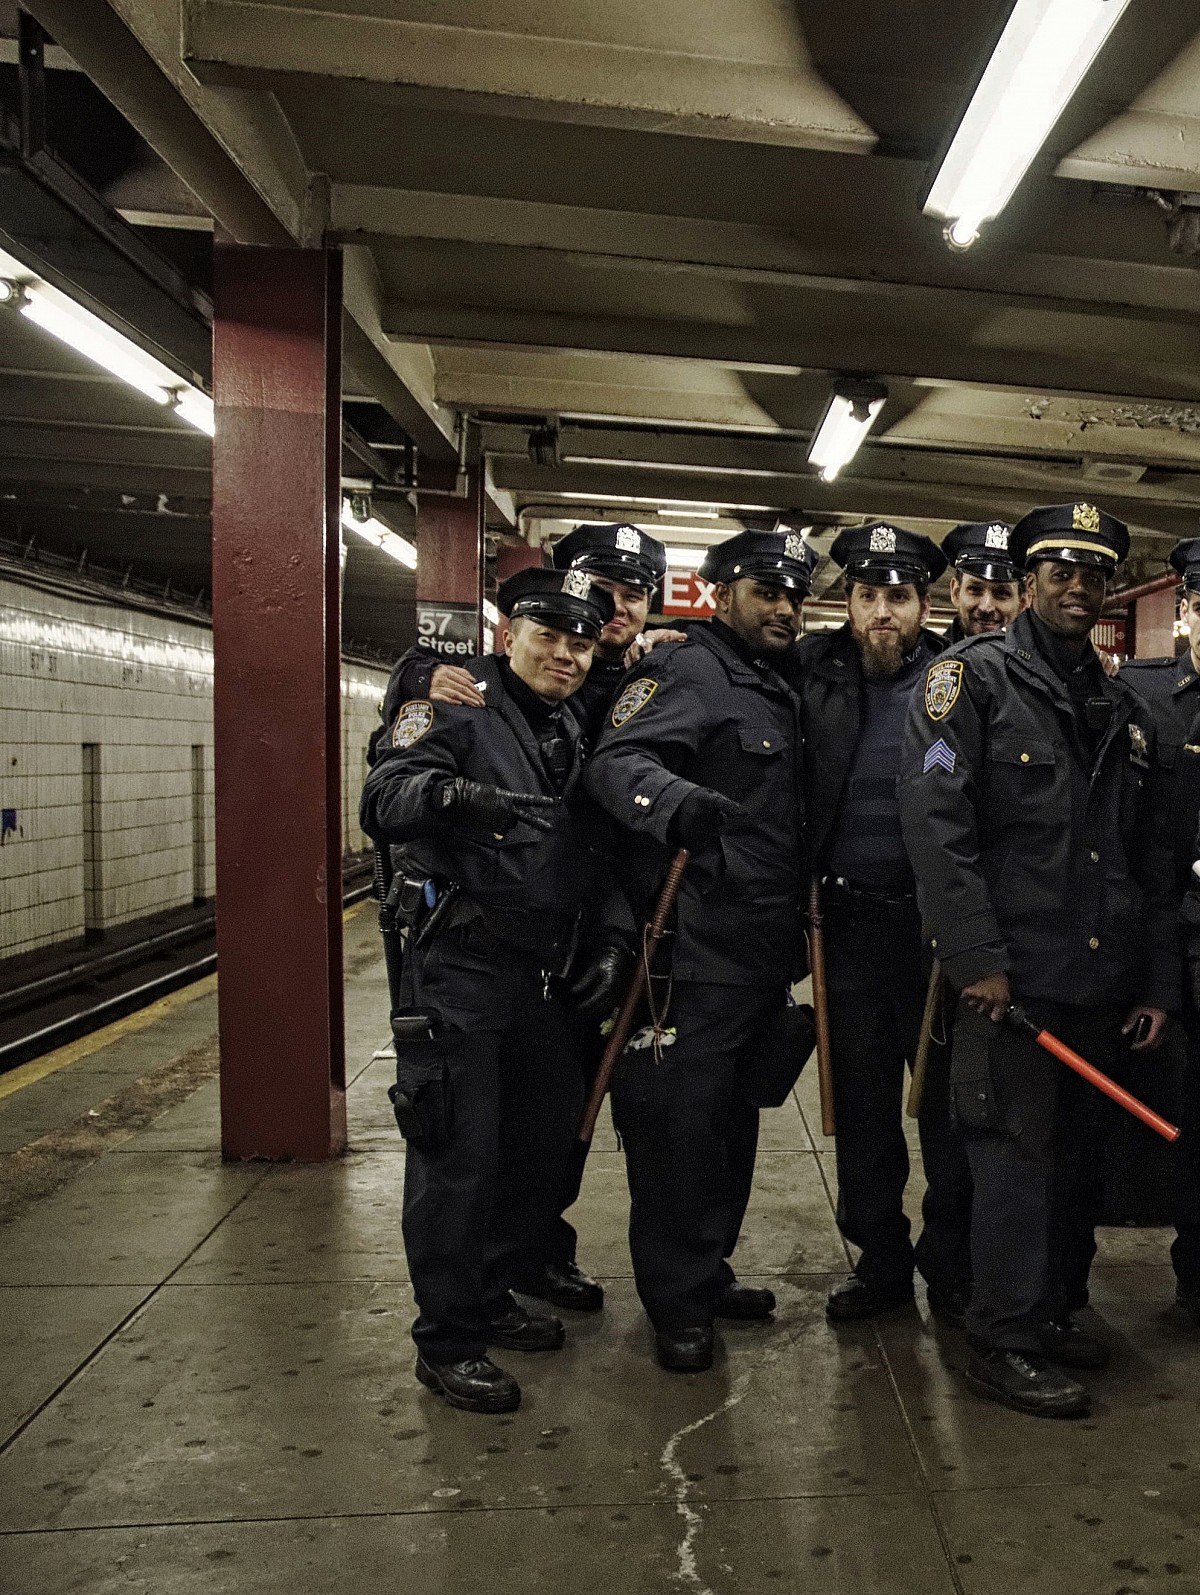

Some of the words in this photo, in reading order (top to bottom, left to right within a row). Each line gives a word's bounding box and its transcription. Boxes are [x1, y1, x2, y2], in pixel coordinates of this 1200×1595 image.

[664, 571, 717, 609] Ex
[418, 611, 453, 635] 57
[417, 636, 475, 656] Street
